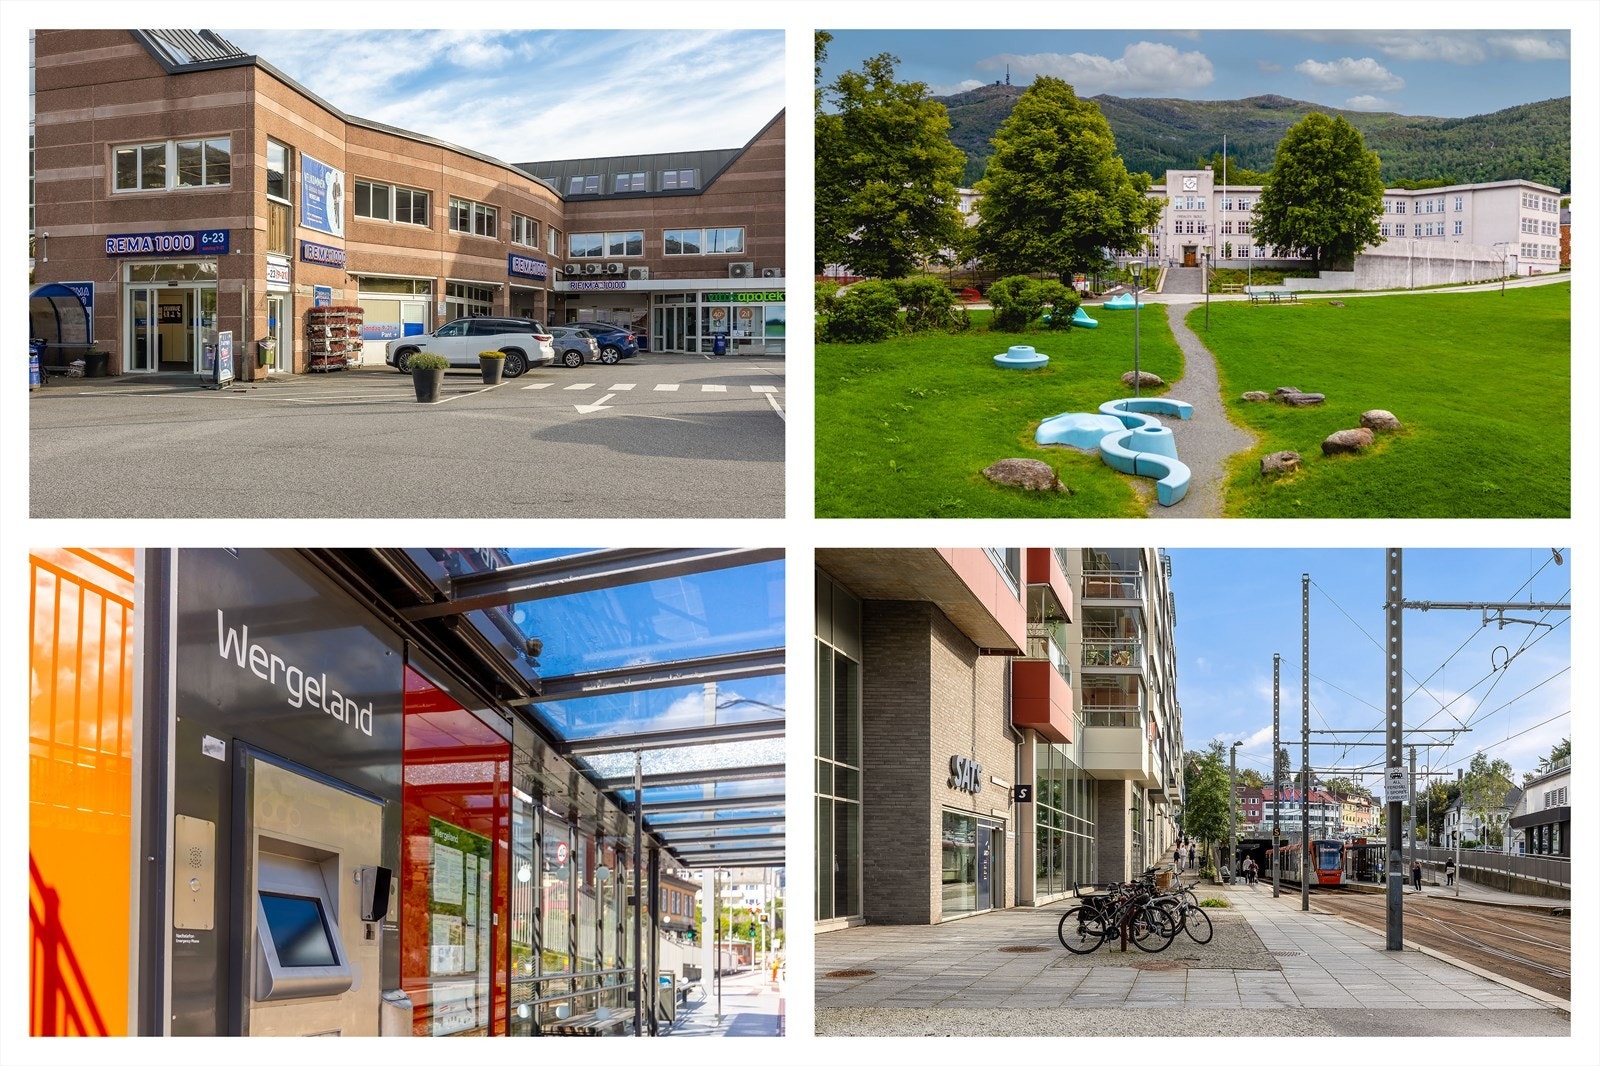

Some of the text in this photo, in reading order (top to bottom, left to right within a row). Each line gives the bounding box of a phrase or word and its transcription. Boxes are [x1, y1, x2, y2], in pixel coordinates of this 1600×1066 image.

[106, 234, 194, 253] REMA 1000
[202, 232, 224, 243] 6-23
[306, 244, 331, 261] REMA
[603, 281, 626, 289] 1000
[217, 608, 373, 737] Wergeland
[952, 755, 982, 793] SATS
[1018, 788, 1028, 799] S
